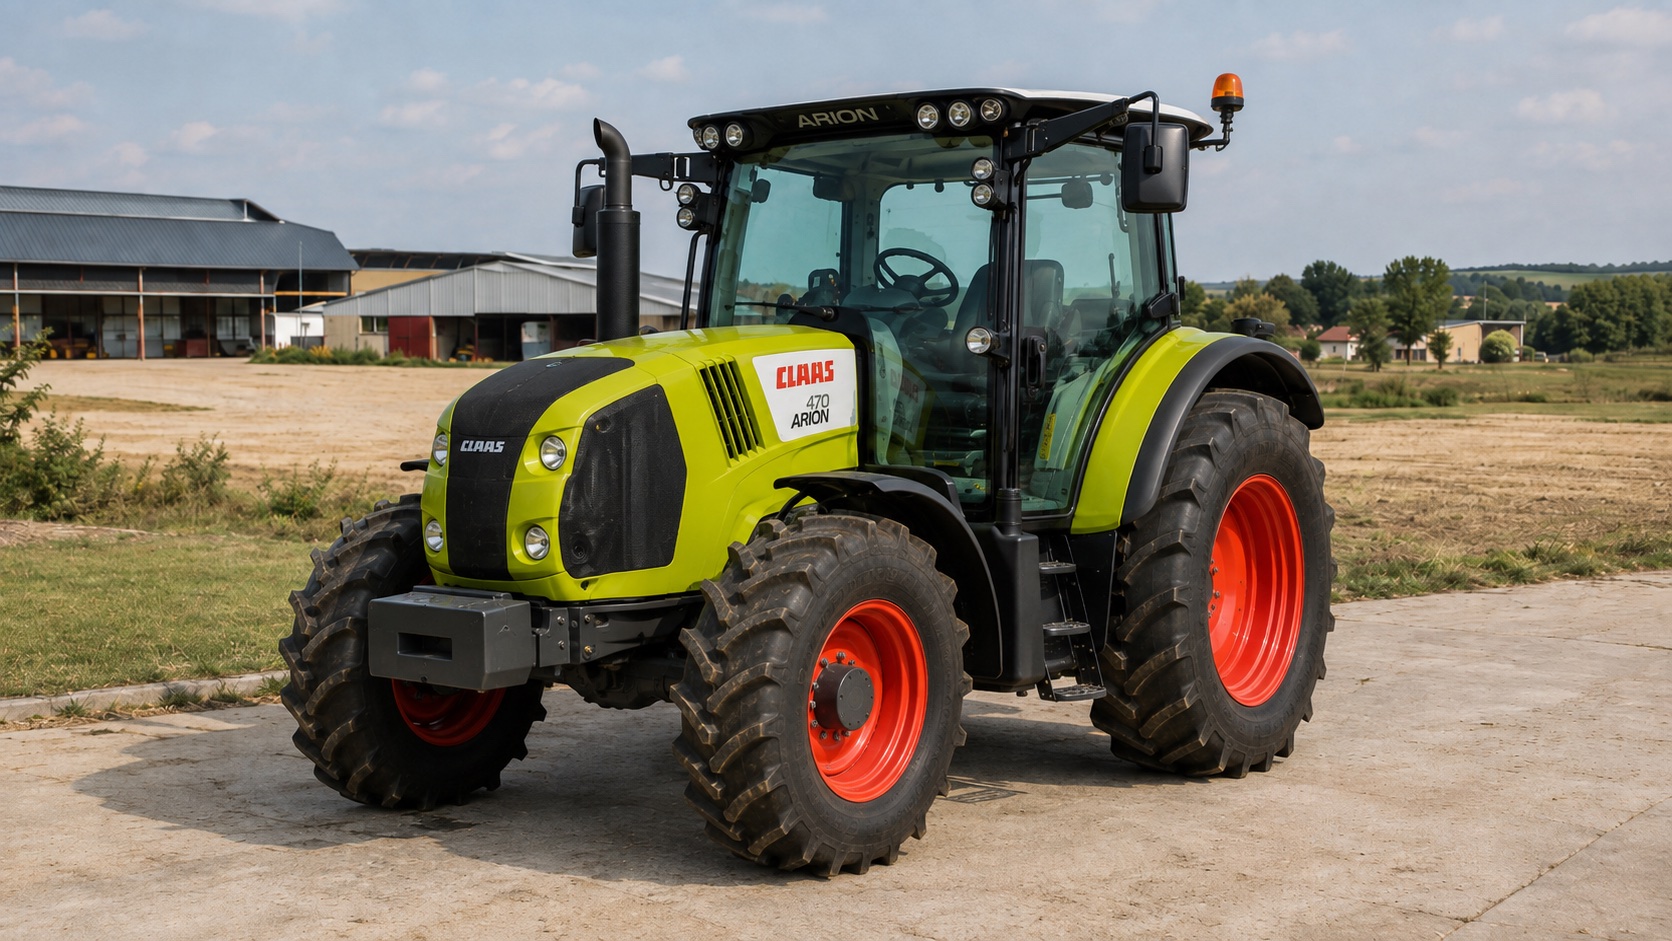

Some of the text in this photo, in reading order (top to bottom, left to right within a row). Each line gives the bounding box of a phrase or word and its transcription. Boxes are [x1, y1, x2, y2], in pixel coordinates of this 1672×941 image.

[798, 107, 879, 128] ARION
[776, 360, 834, 389] CLAAS
[806, 394, 830, 410] 470
[791, 409, 829, 429] ARION
[460, 440, 505, 453] CLAAS
